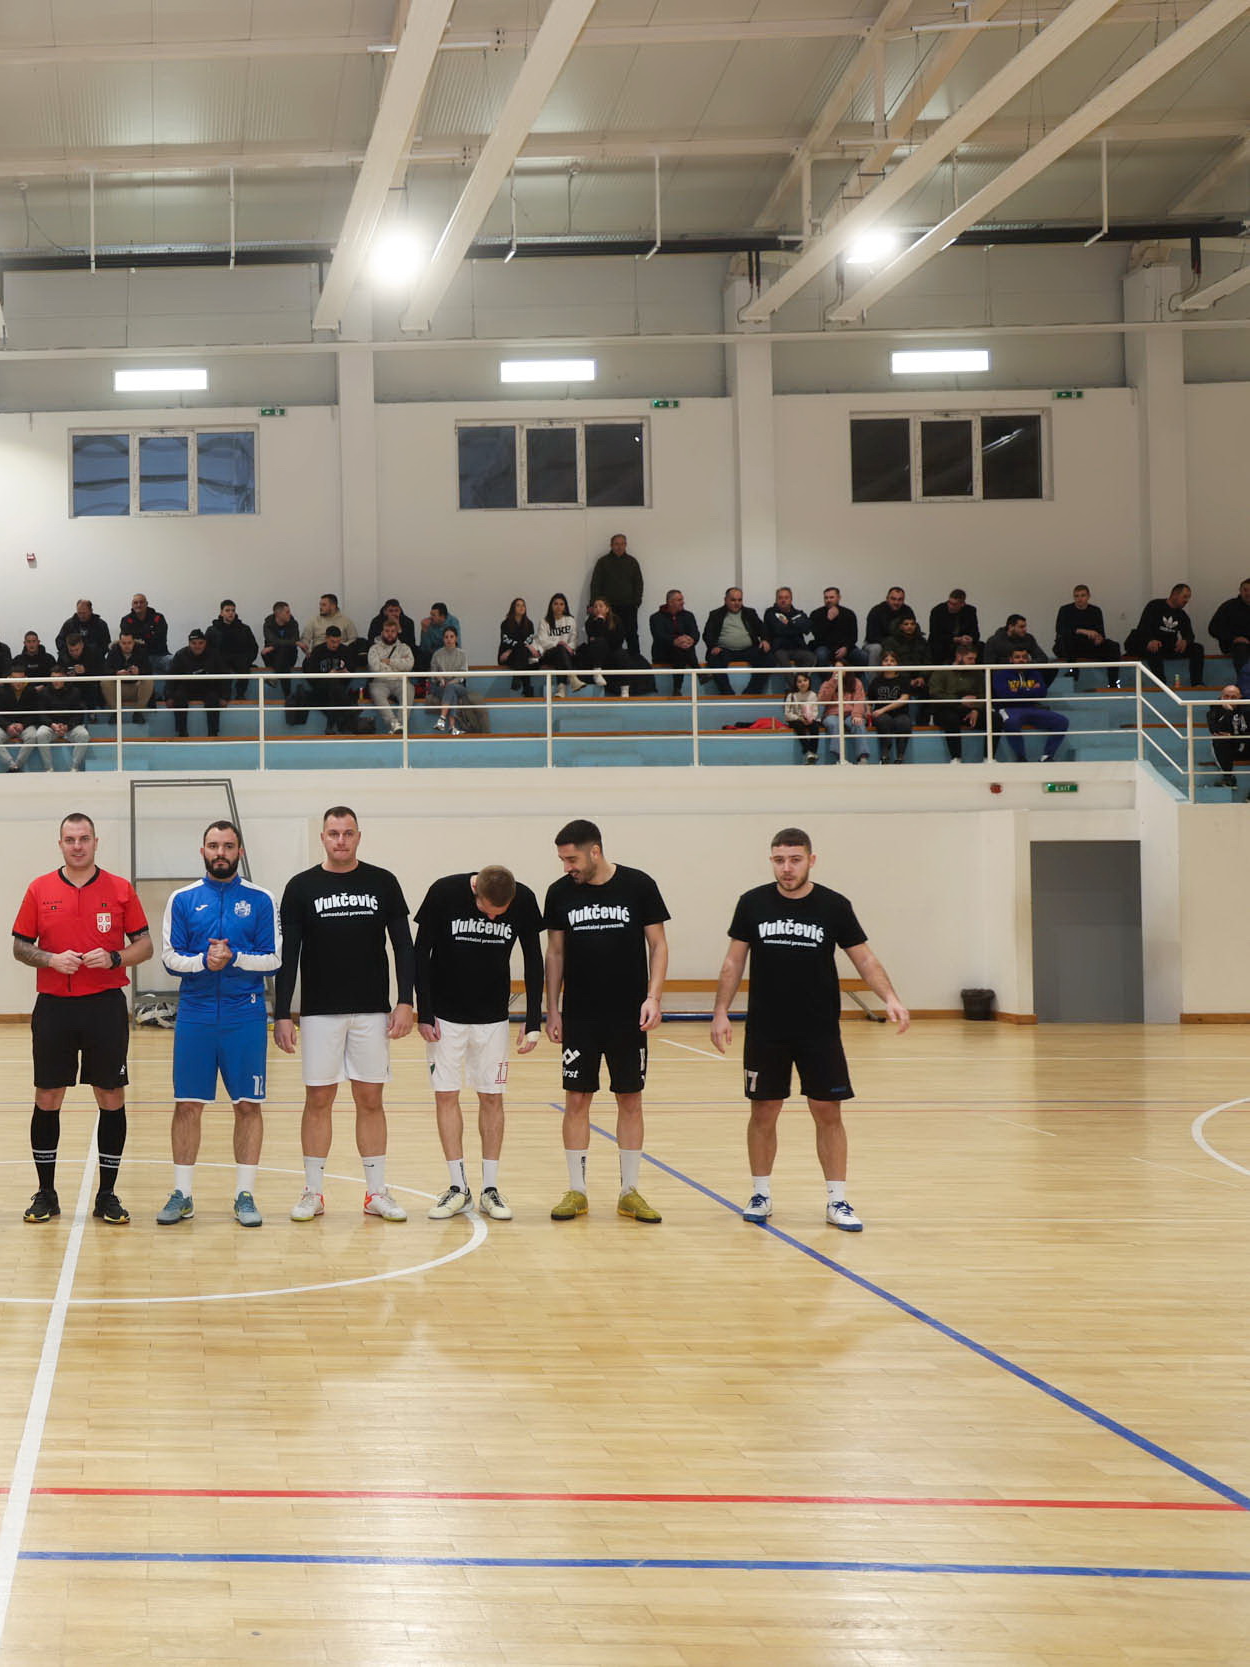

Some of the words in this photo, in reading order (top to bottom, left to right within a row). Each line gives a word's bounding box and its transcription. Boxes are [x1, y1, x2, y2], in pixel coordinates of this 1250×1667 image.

[314, 892, 379, 913] Vukčević
[567, 903, 631, 927] Vukčević
[451, 918, 513, 940] Vukčević
[758, 918, 825, 943] Vukčević
[562, 1067, 580, 1079] irst
